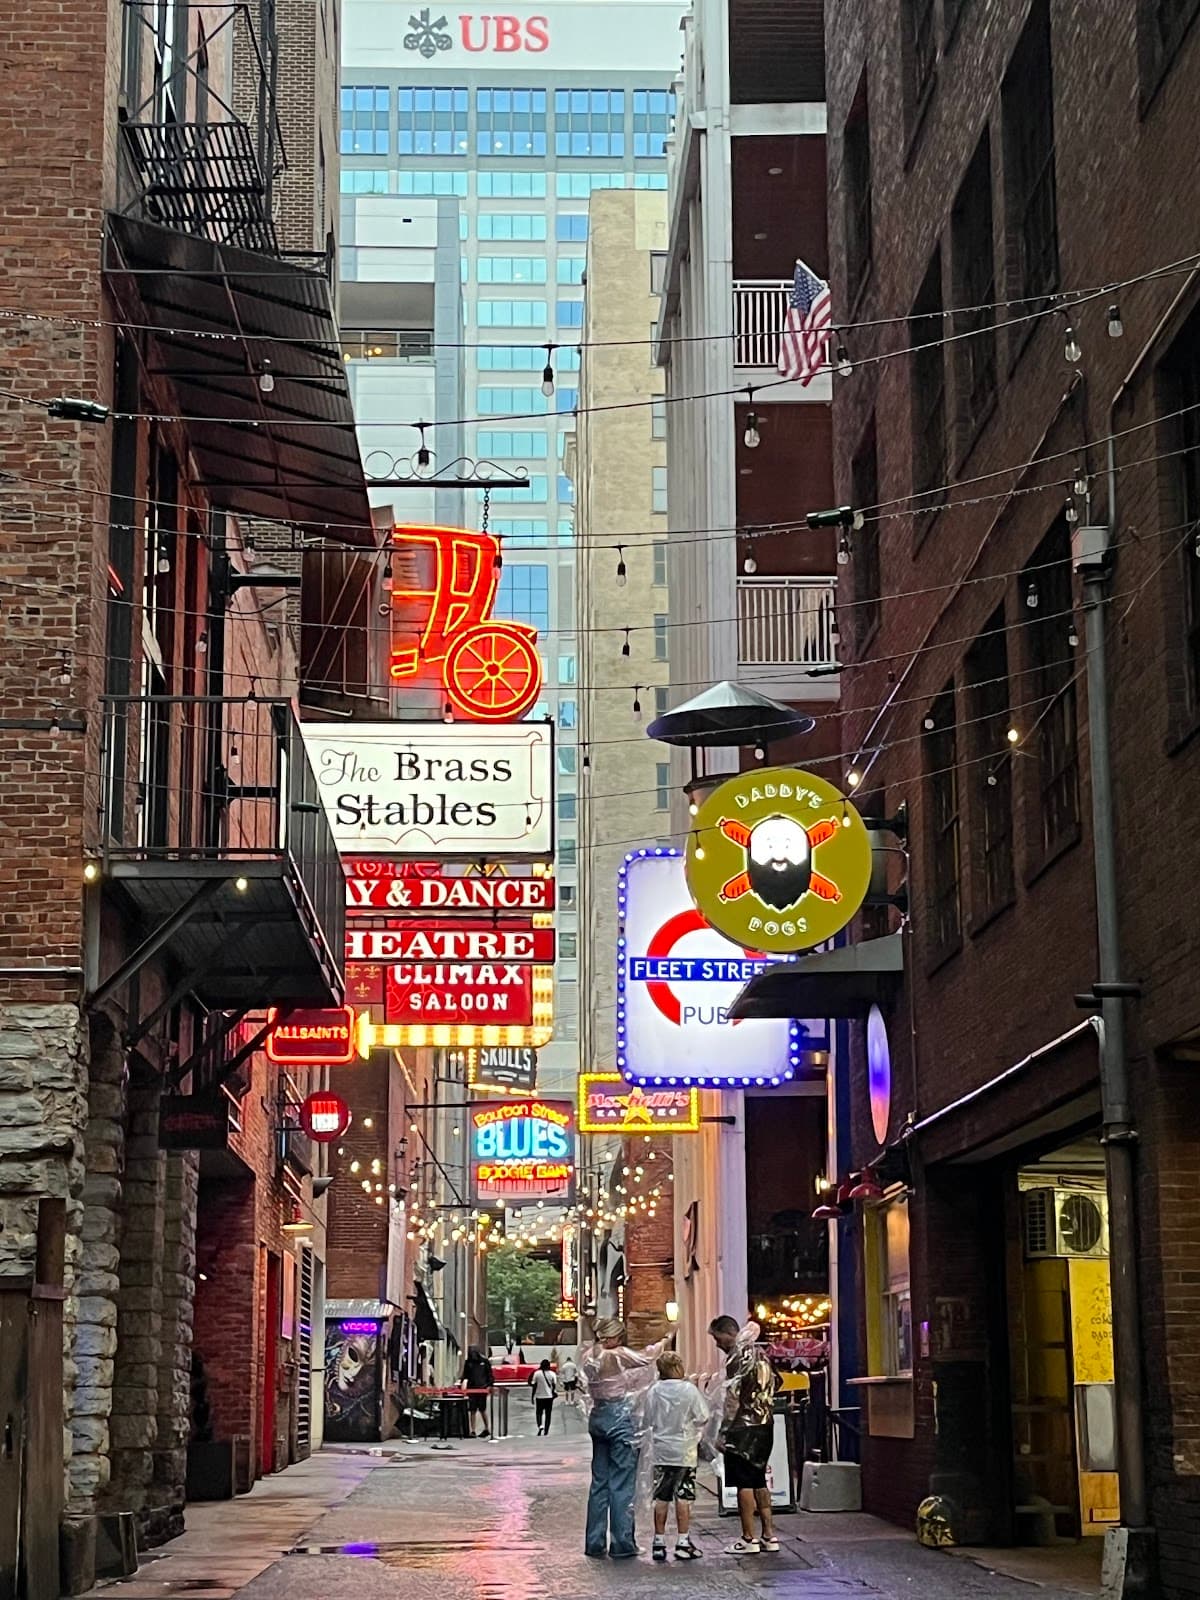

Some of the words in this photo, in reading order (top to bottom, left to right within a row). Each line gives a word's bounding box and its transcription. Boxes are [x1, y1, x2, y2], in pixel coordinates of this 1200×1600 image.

[459, 15, 550, 52] UBS
[319, 748, 382, 786] The
[394, 751, 512, 782] Brass
[734, 782, 824, 810] DADDY'S
[336, 794, 497, 826] Stables
[386, 879, 412, 907] &
[420, 880, 546, 907] DANCE
[748, 917, 809, 937] DOGS
[393, 964, 524, 985] CLIMAX
[634, 961, 696, 979] FLEET
[702, 962, 774, 979] STREE
[409, 993, 509, 1011] SALOON
[683, 1006, 730, 1025] PUB
[273, 1026, 349, 1040] ALLSAINTS
[481, 1047, 532, 1071] SKULLS
[474, 1104, 529, 1127] Bourbon
[531, 1102, 570, 1126] Street
[477, 1118, 568, 1157] BLUES
[478, 1165, 534, 1180] BOOGIE
